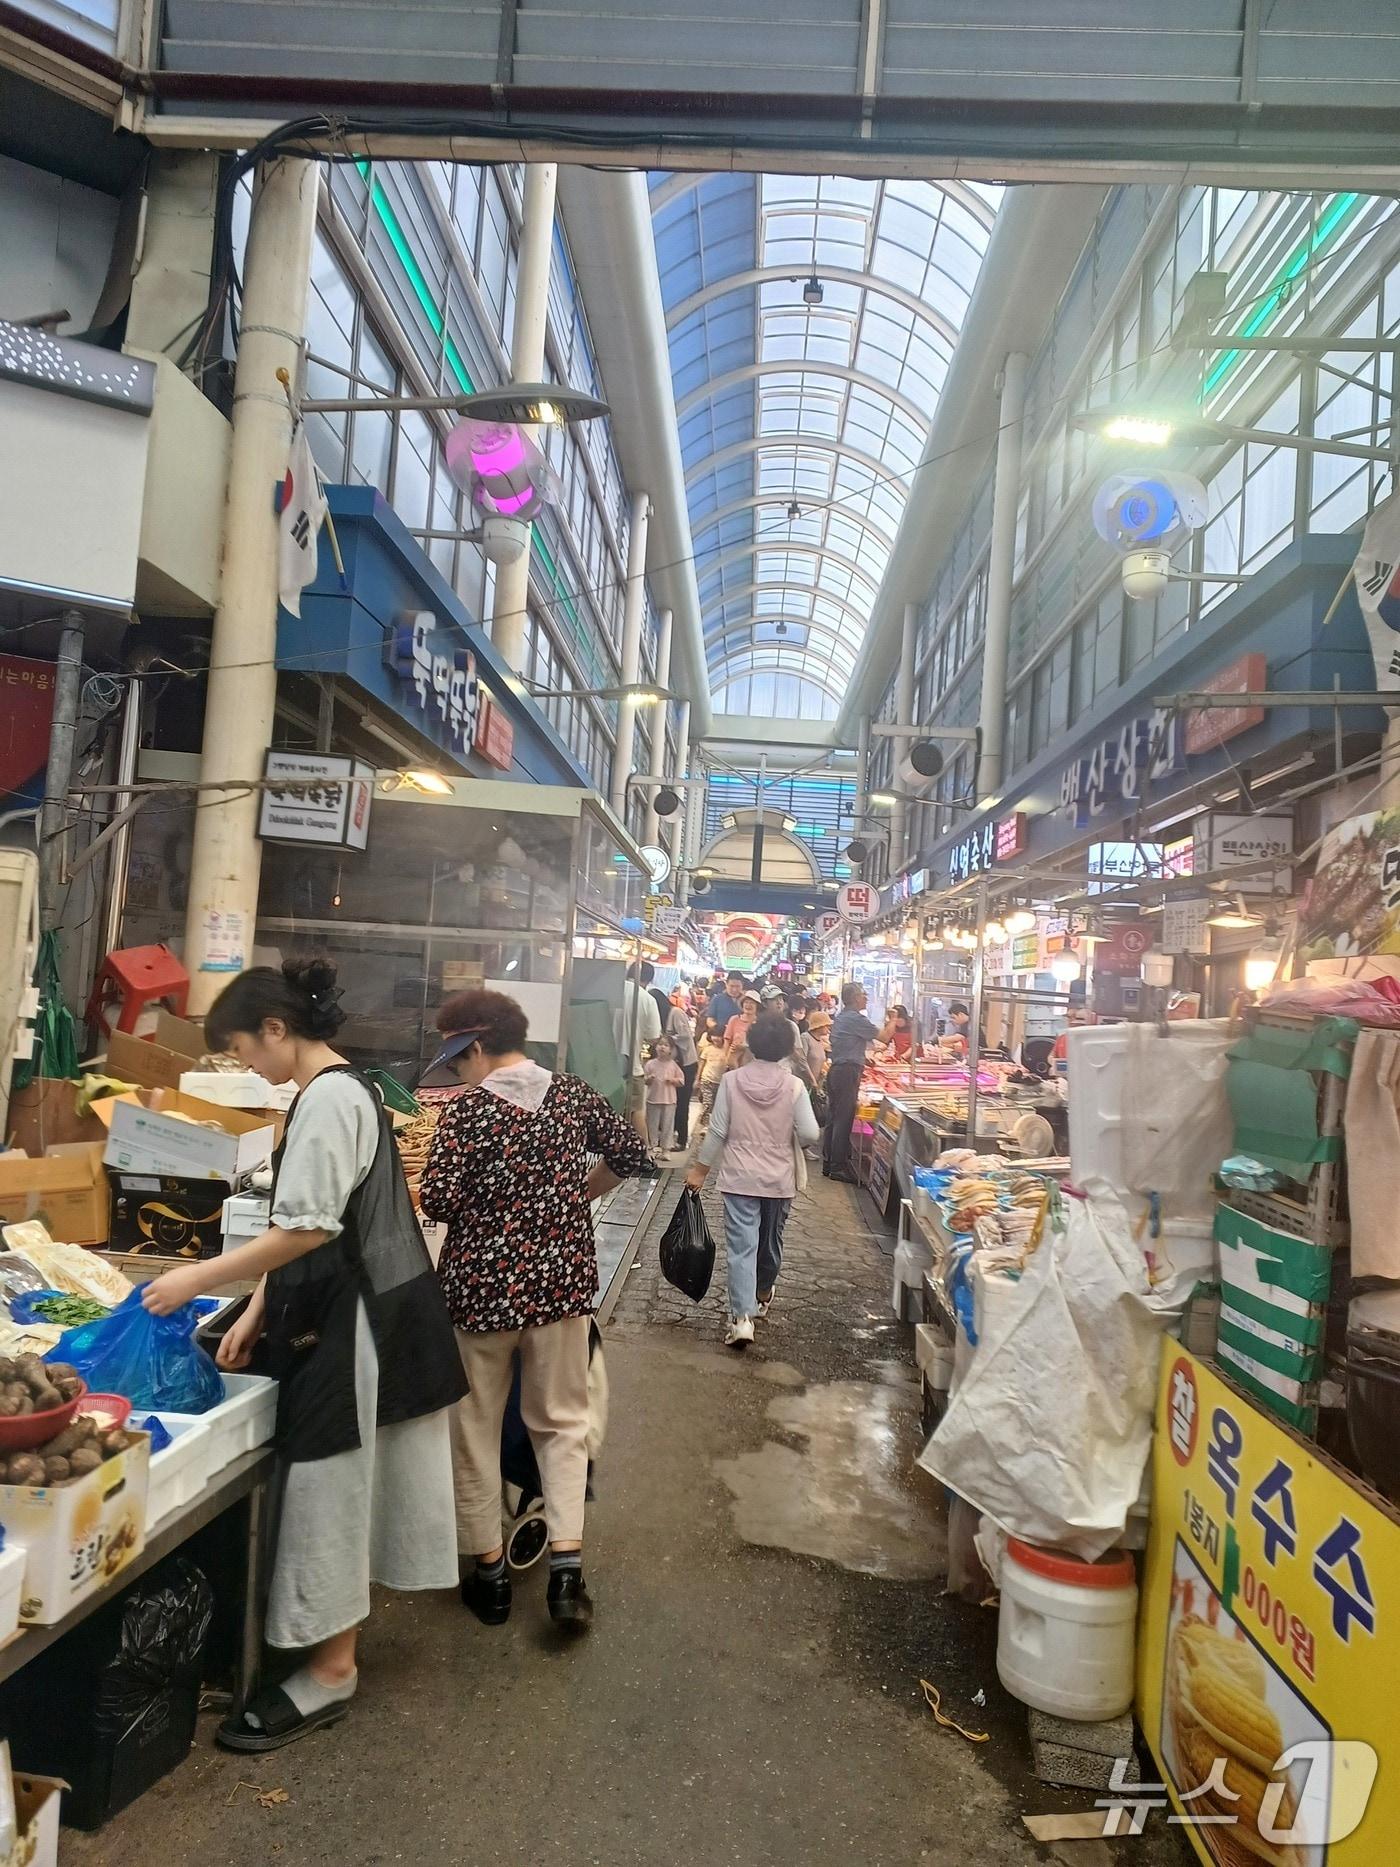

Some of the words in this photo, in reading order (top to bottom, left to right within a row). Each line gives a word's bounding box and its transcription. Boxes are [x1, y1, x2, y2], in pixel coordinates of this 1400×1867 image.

[847, 887, 870, 912] 떡
[1172, 1367, 1197, 1457] 찰
[1184, 1489, 1219, 1566] 1봉지
[1243, 1565, 1316, 1683] 000원
[1207, 1407, 1376, 1643] 옥수수
